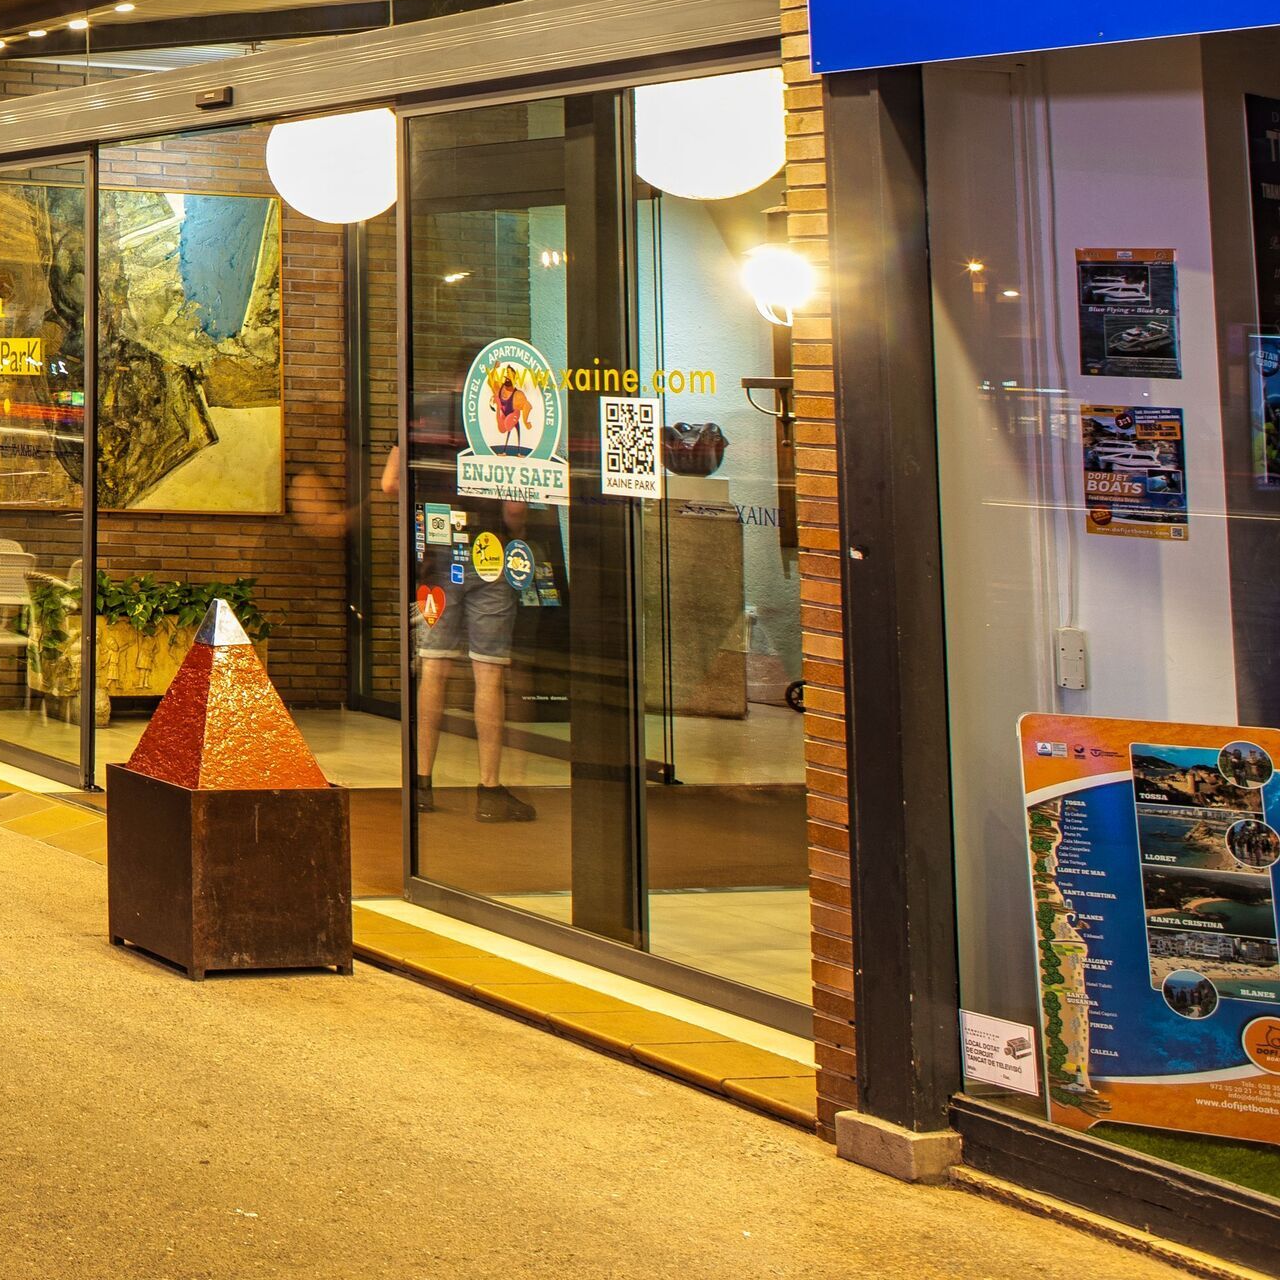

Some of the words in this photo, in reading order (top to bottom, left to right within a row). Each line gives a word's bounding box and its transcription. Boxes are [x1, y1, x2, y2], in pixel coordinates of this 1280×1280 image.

[486, 357, 717, 395] www.xaine.com
[468, 378, 481, 422] HOTEL
[462, 463, 515, 483] ENJOY
[520, 468, 563, 488] SAFE
[1088, 472, 1110, 480] DOFI
[606, 477, 633, 489] XAINE
[635, 480, 656, 491] PARK
[1087, 480, 1142, 494] BOATS
[495, 485, 535, 504] XAINE
[735, 504, 784, 528] XAINE
[1145, 854, 1177, 862] LLORET
[1086, 891, 1117, 899] CRISTINA
[1151, 916, 1181, 925] SANTA
[1182, 918, 1224, 929] CRISTINA
[1240, 989, 1276, 998] BLANES
[1067, 998, 1098, 1006] SUSANNA
[966, 1039, 983, 1048] LOCAL
[983, 1043, 1000, 1052] DOTAT
[974, 1048, 993, 1058] CIRCUIT
[1090, 1049, 1119, 1057] CALELLA
[967, 1054, 987, 1064] TANCAT
[996, 1061, 1022, 1073] TELEVISIÓ
